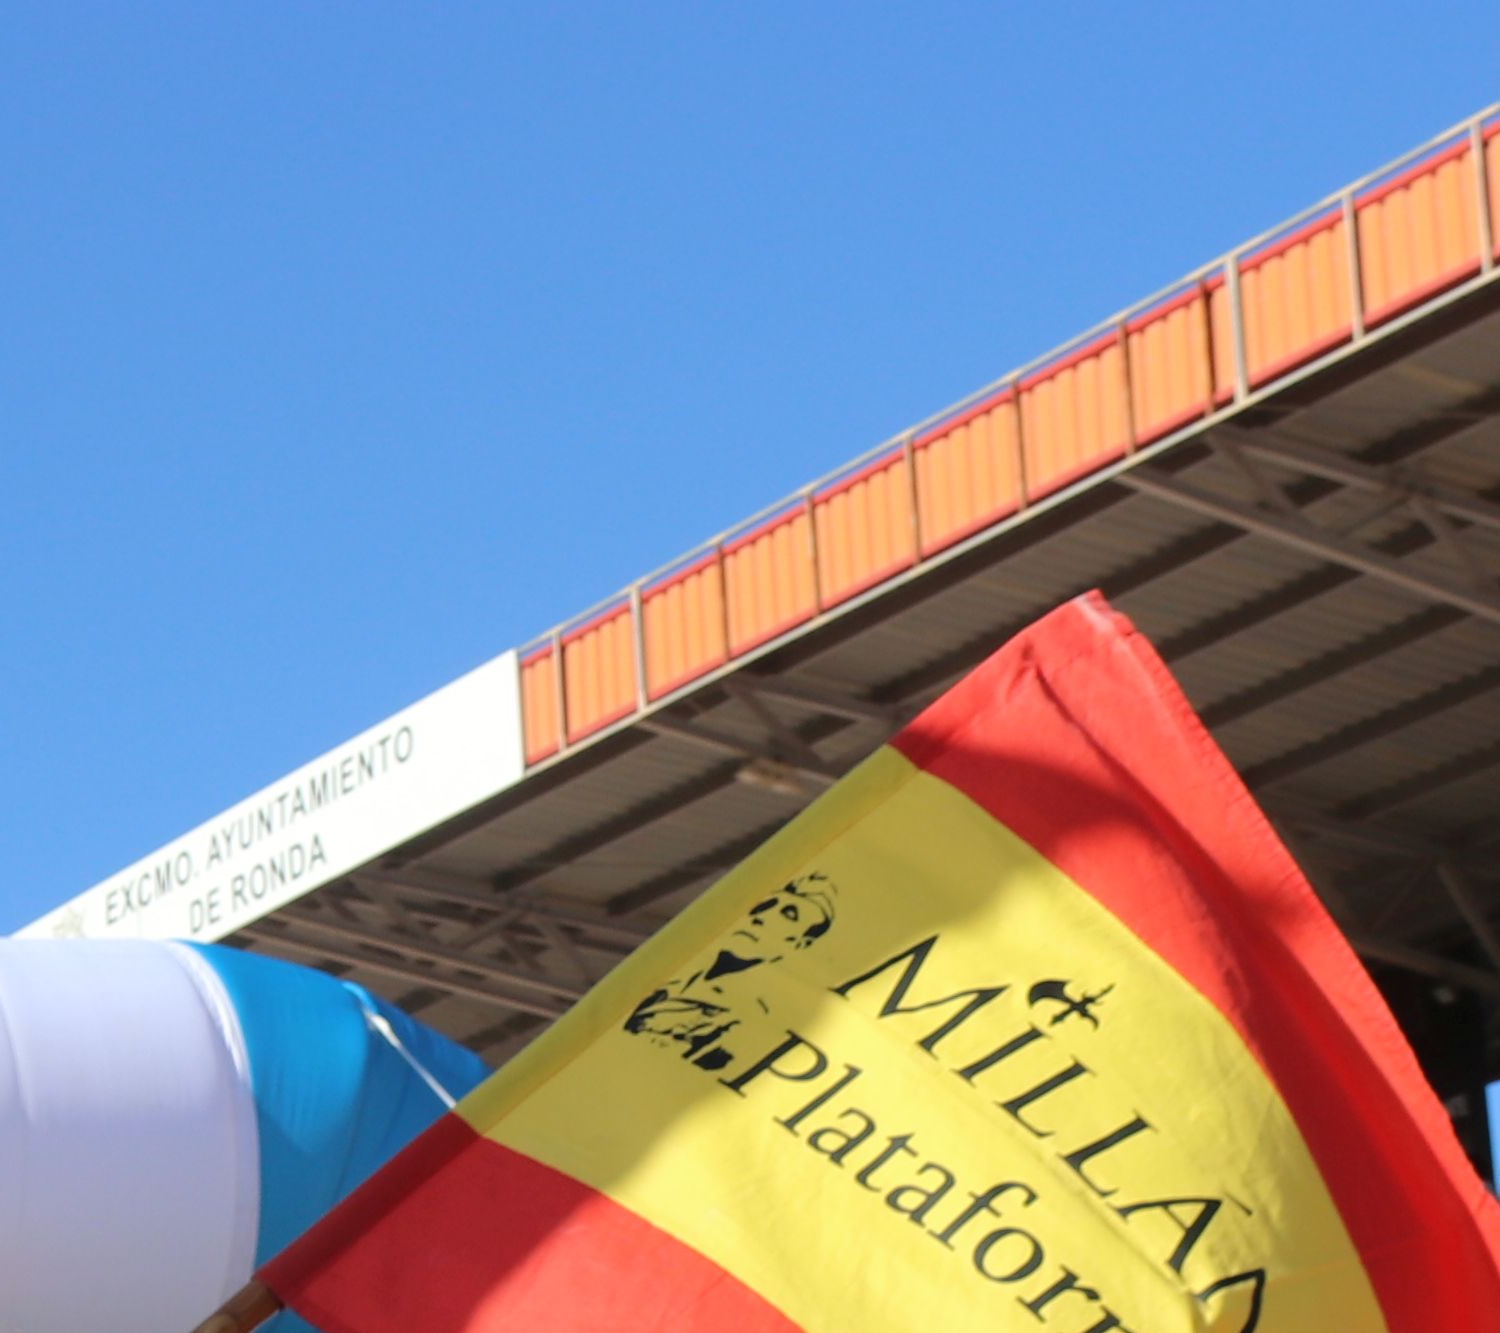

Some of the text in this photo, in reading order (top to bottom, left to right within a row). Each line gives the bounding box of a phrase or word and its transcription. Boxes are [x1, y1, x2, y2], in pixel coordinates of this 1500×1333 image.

[103, 724, 415, 927] EXCMO. AYUNTAMIENTO
[189, 833, 328, 934] DE RONDA
